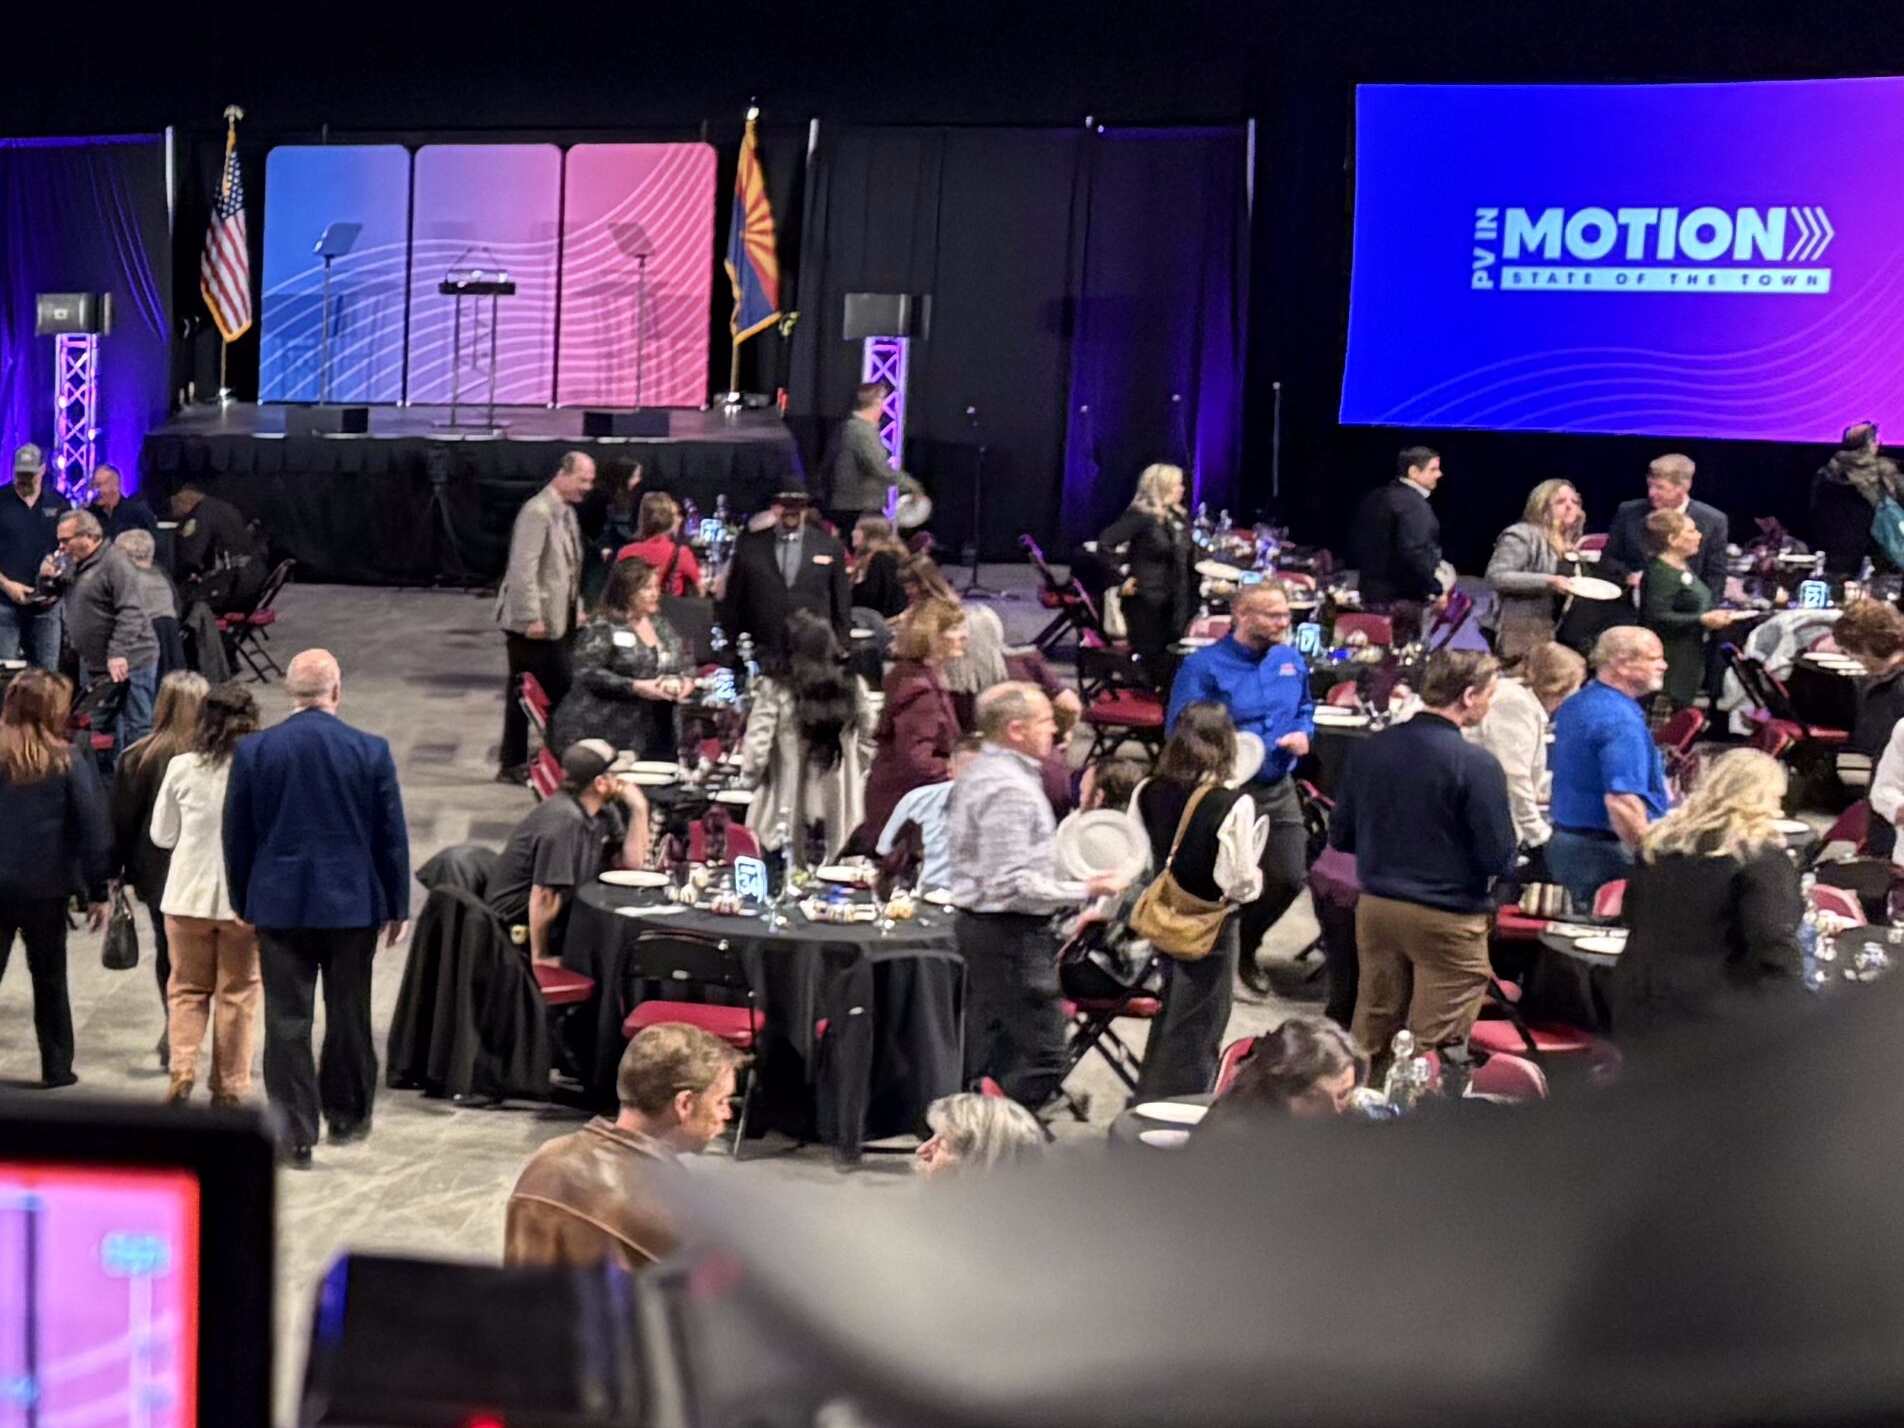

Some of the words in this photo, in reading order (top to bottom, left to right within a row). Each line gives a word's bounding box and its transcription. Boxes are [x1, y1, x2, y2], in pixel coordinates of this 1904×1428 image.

[1474, 207, 1499, 241] IN
[1501, 206, 1788, 262] MOTION
[1472, 248, 1496, 290] PV
[1511, 272, 1593, 285] STATE
[1616, 272, 1646, 285] OF
[1670, 273, 1717, 286] THE
[1741, 273, 1819, 286] TOWN
